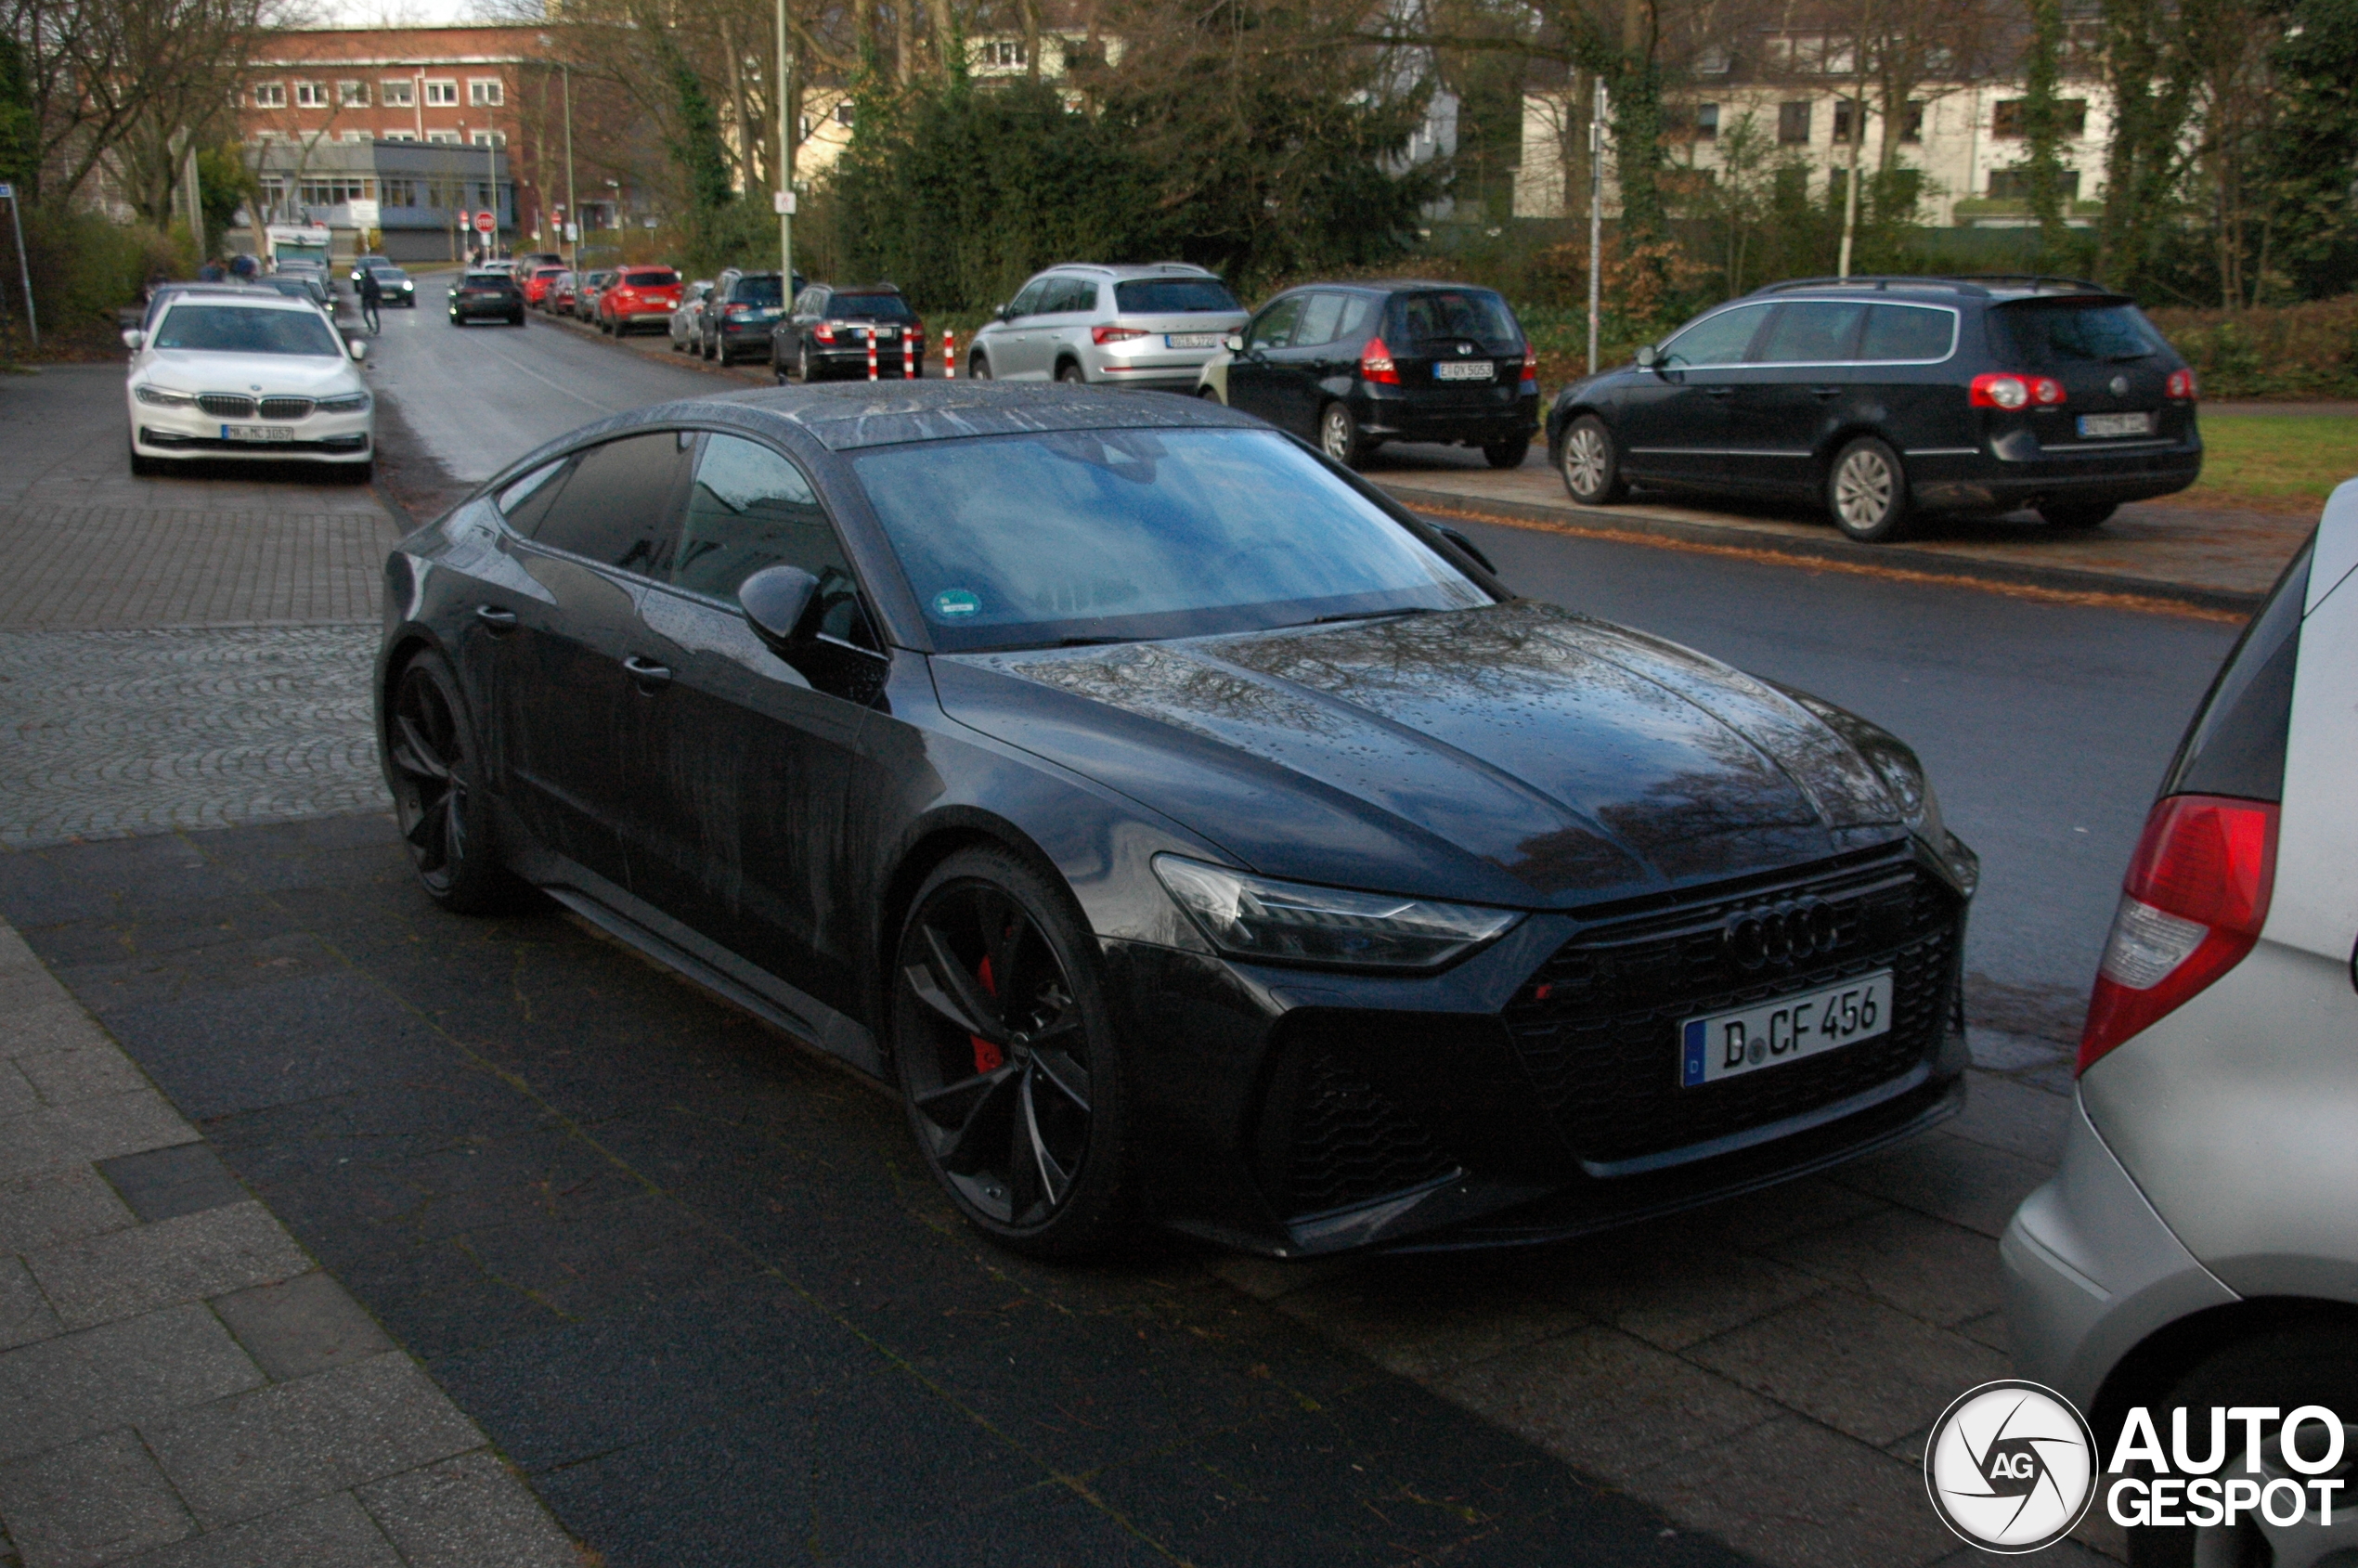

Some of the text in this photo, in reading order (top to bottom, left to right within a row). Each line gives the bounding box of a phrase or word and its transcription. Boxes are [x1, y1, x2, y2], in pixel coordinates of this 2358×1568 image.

[477, 218, 495, 228] STOP
[1441, 365, 1447, 376] E
[1724, 986, 1877, 1069] D CF 456
[1690, 1060, 1700, 1074] D
